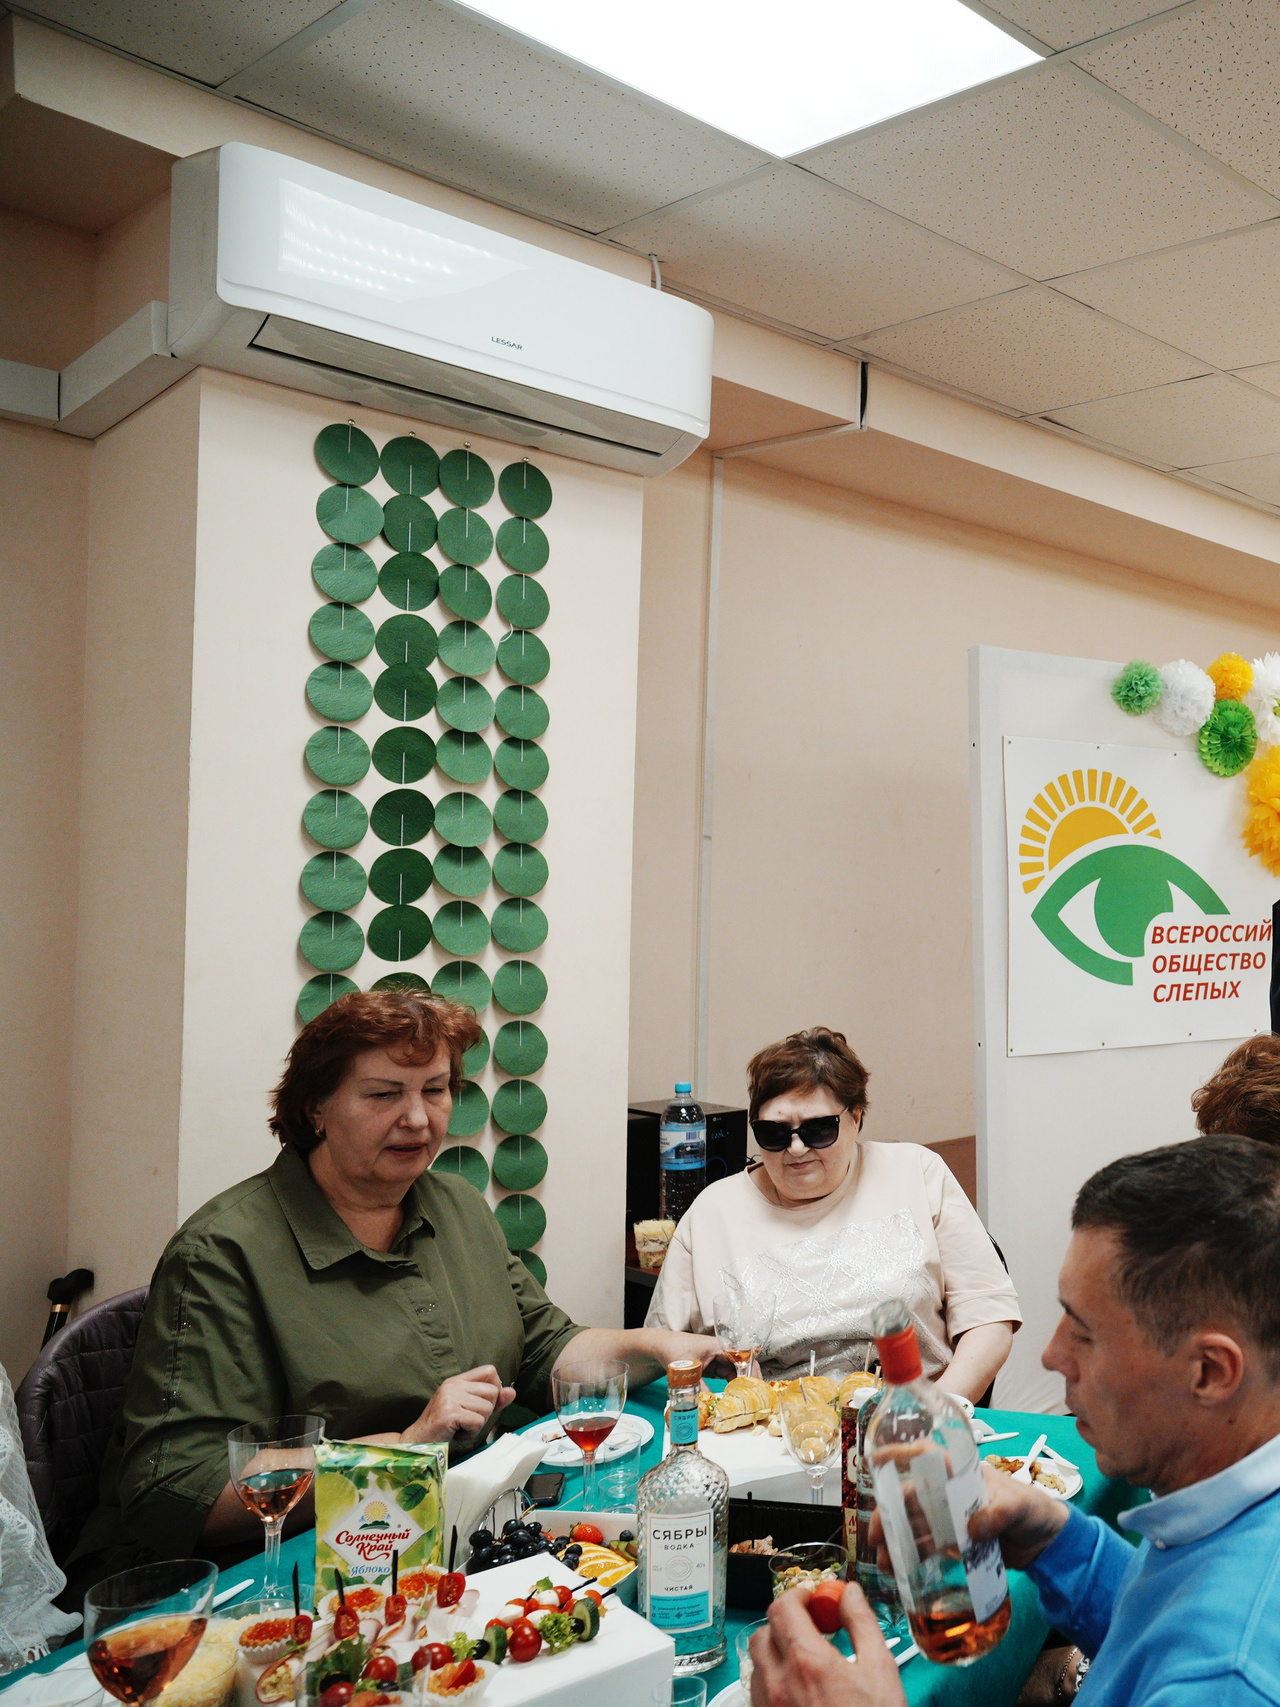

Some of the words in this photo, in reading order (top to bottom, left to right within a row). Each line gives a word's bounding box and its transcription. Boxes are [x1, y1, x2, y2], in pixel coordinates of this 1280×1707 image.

[491, 336, 522, 350] LESSAR
[1151, 918, 1273, 944] ВСЕРОССИЙ
[1152, 951, 1266, 975] ОБЩЕСТВО
[1153, 980, 1241, 1003] СЛЕПЫХ
[335, 1528, 412, 1547] Солнечный
[652, 1526, 707, 1541] СЯБРЫ
[355, 1540, 395, 1561] Край
[351, 1565, 390, 1576] Яблоко
